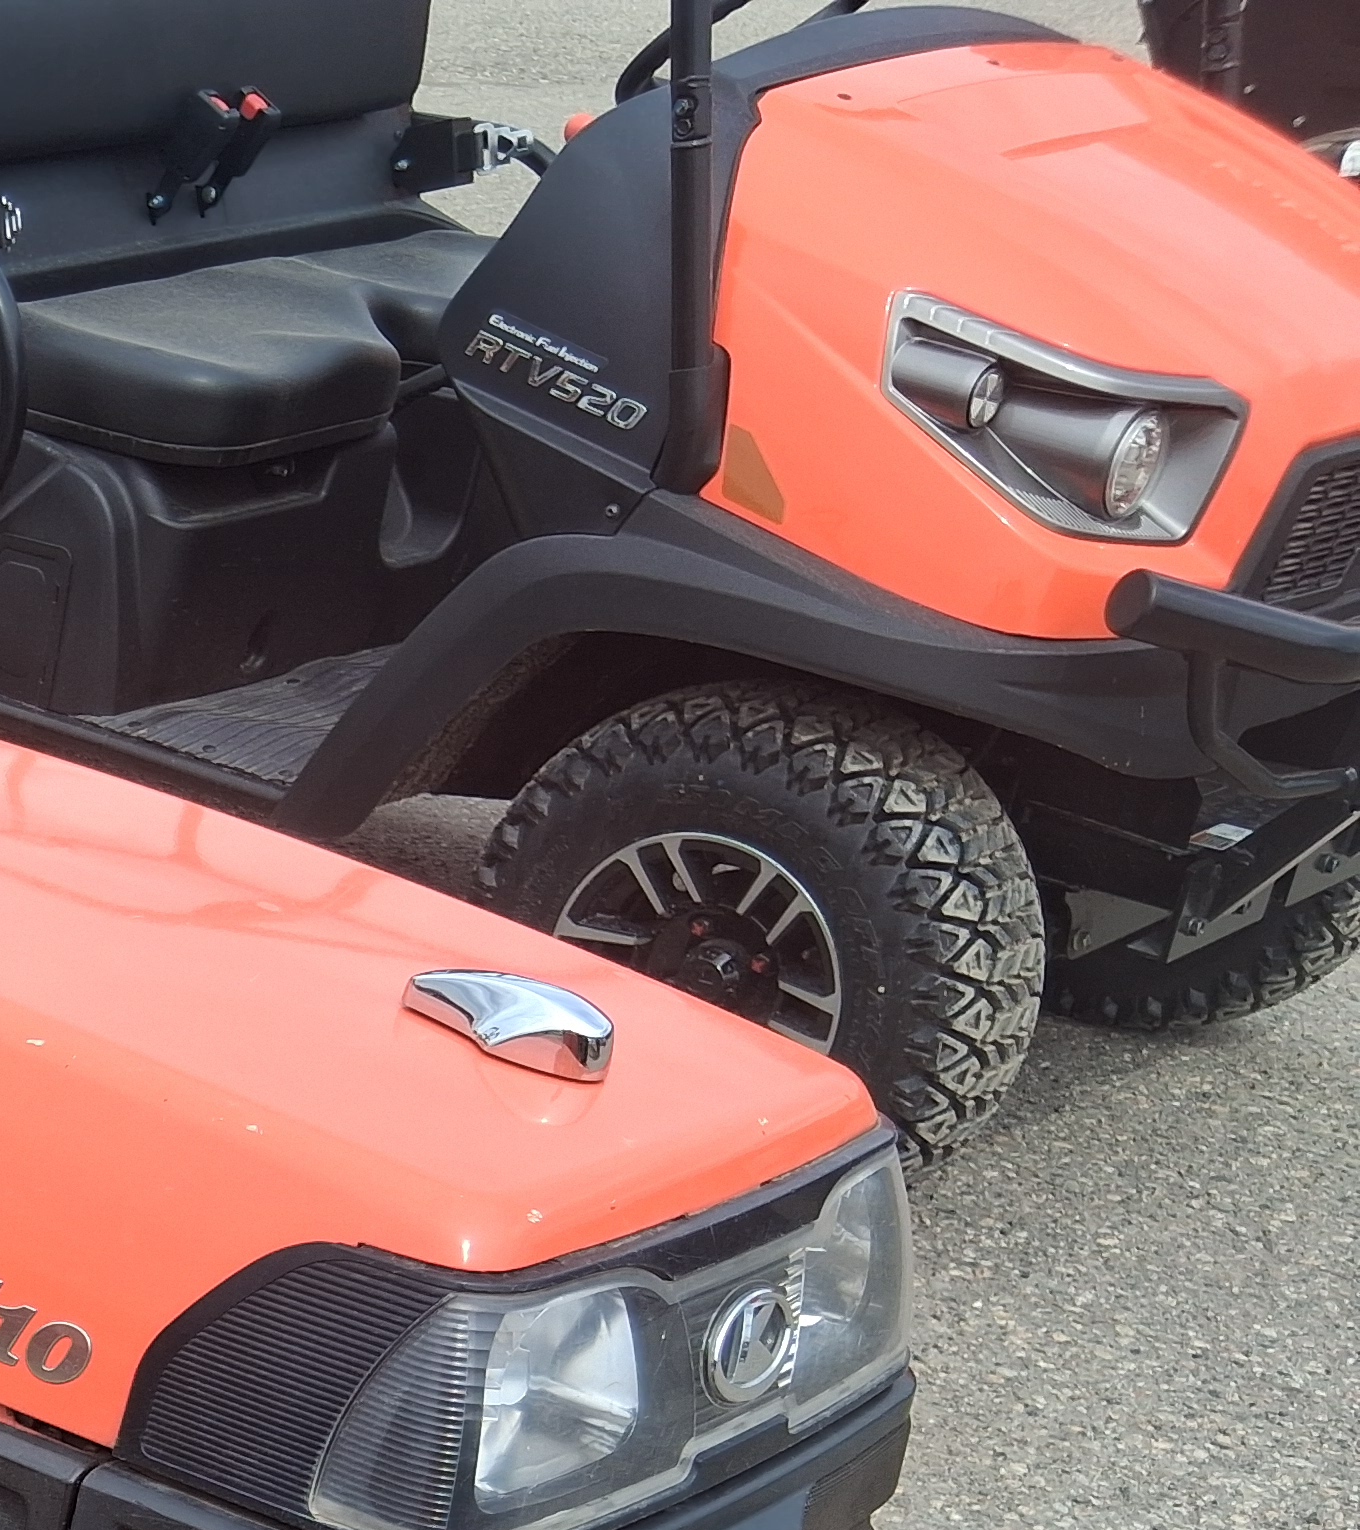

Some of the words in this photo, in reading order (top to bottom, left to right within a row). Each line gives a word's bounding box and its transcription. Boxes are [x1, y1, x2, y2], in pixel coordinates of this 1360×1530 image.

[464, 329, 648, 430] RTV520
[488, 313, 536, 344] Electronic
[535, 336, 560, 354] Fuel
[557, 346, 599, 373] Injection
